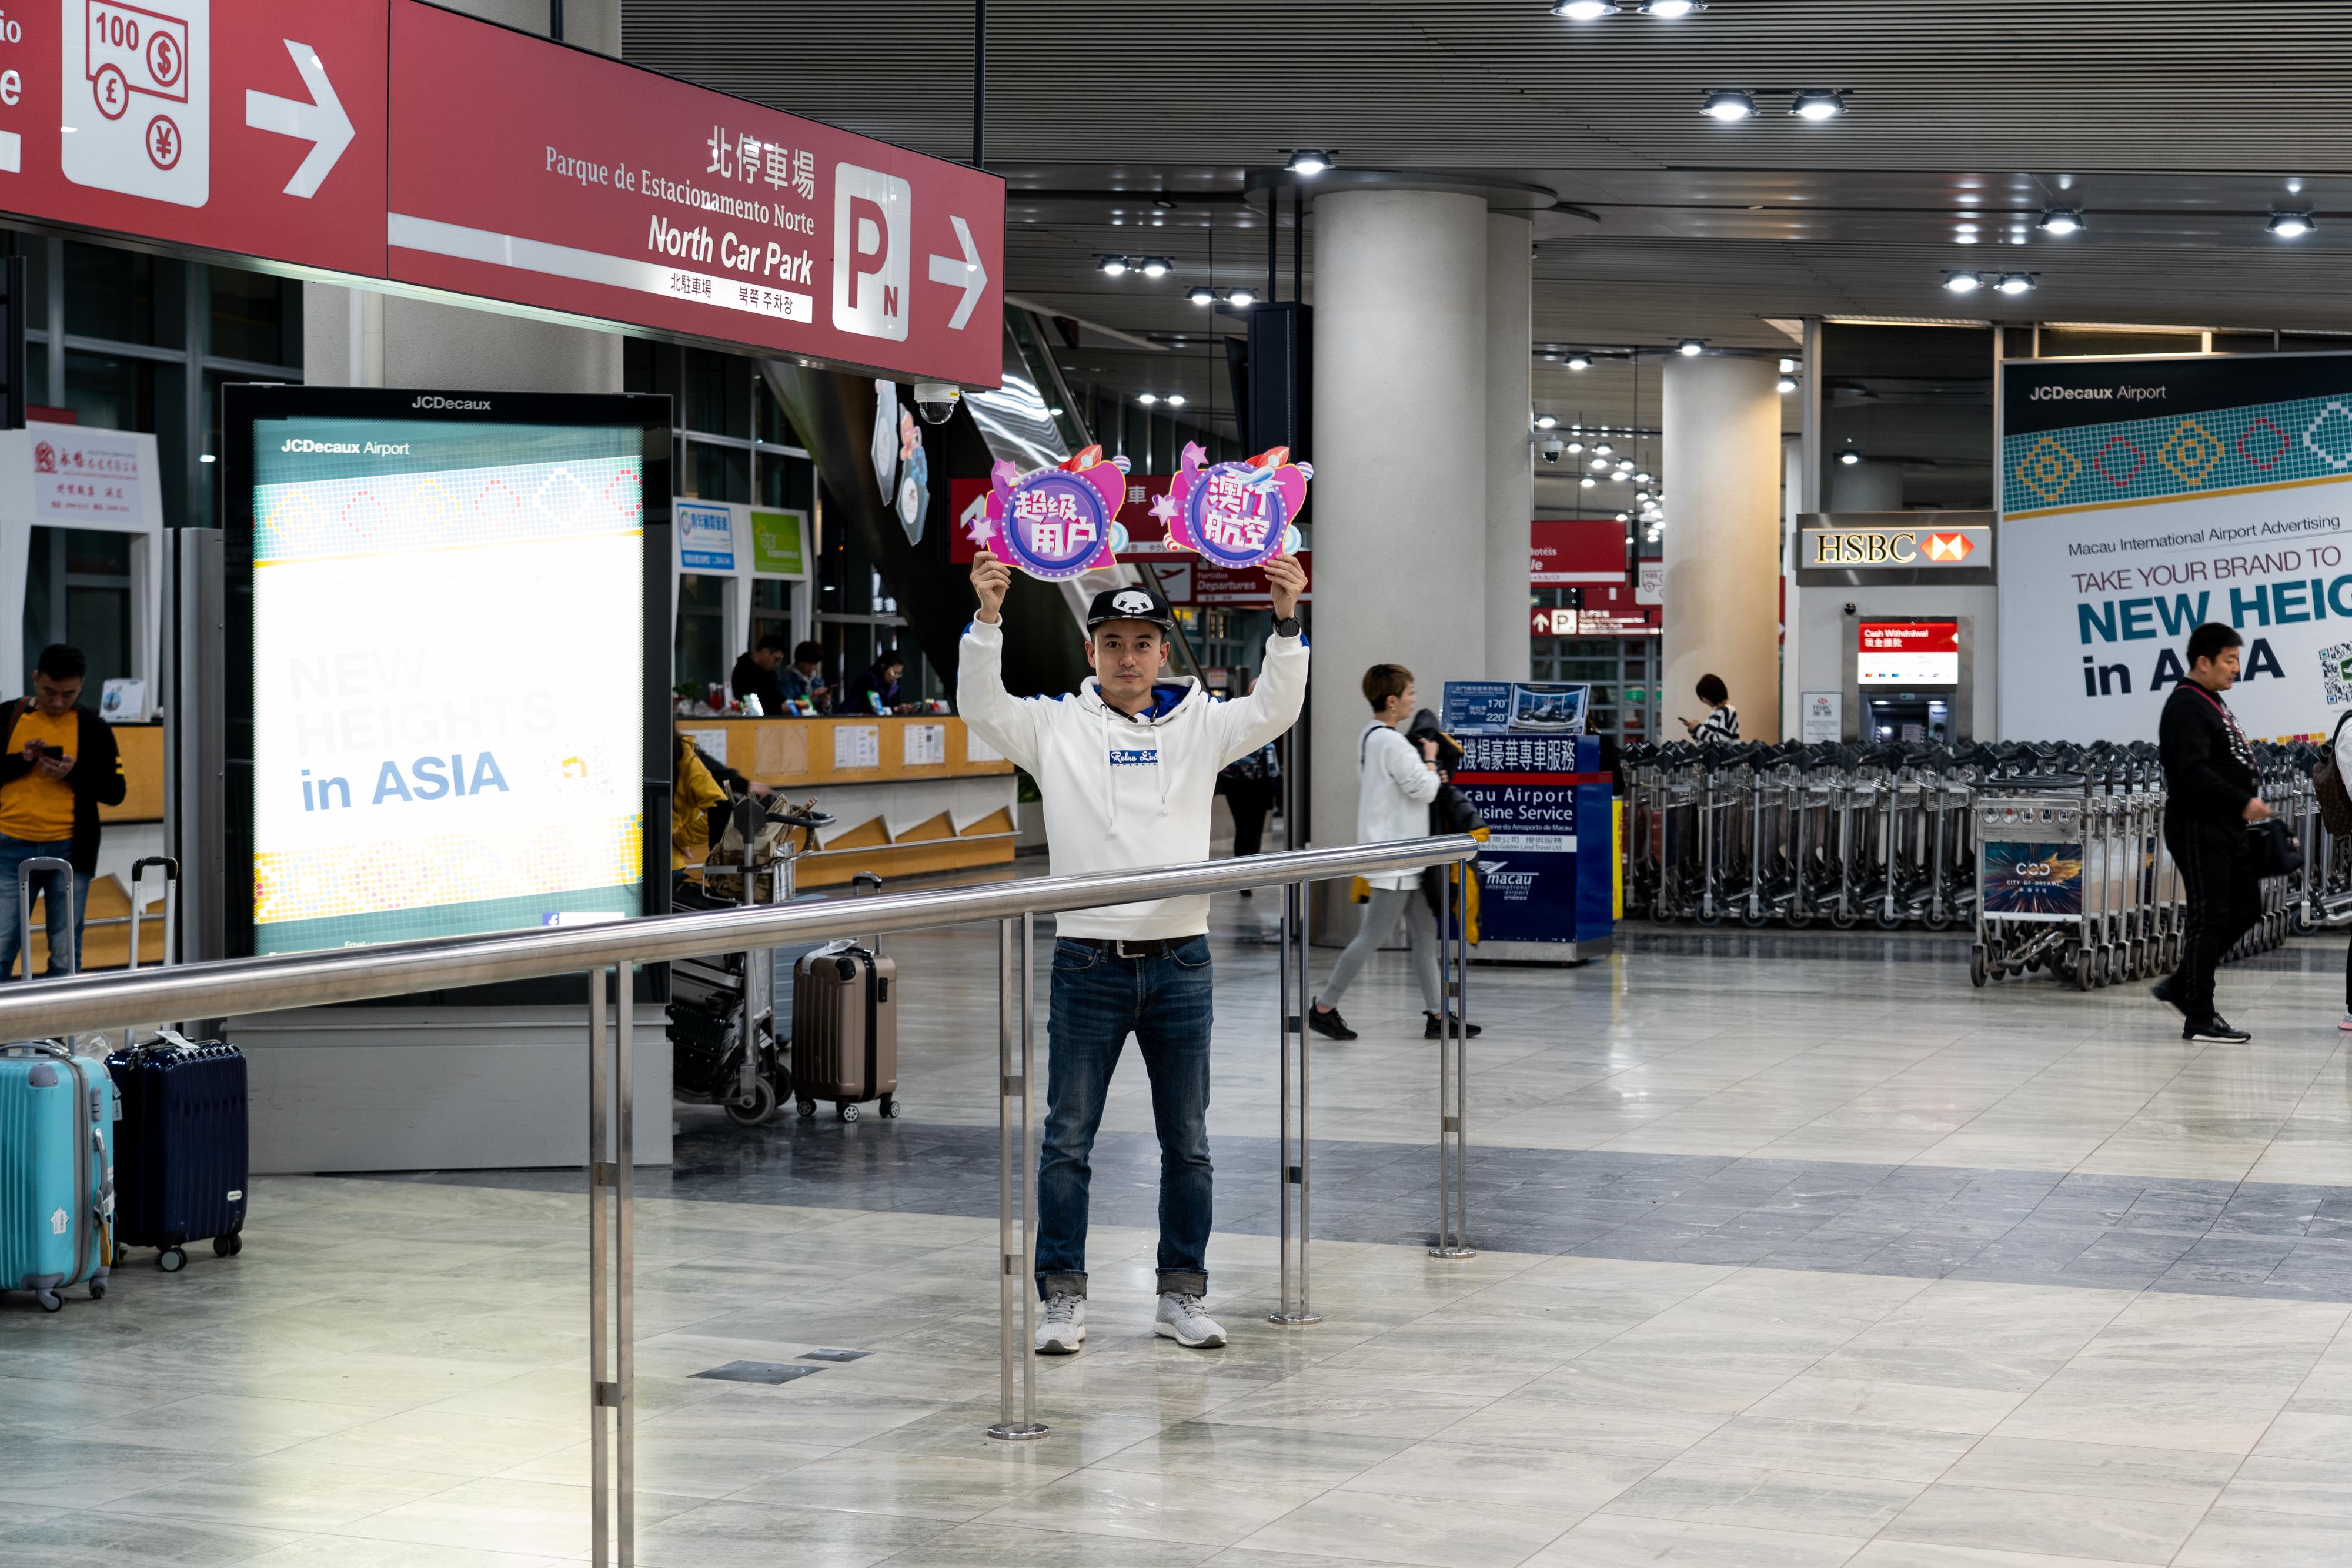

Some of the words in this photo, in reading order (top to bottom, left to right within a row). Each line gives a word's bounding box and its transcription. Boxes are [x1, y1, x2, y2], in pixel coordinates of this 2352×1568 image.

[96, 12, 139, 51] 100
[707, 125, 815, 200] 北停車場
[546, 146, 608, 186] Parque
[614, 162, 635, 192] de
[641, 169, 769, 224] Estacionamento
[773, 203, 814, 236] Norte
[647, 214, 714, 263] North
[721, 232, 761, 273] Car
[764, 242, 813, 285] Park
[848, 195, 888, 309] P
[671, 272, 711, 299] 北駐車場
[739, 286, 759, 308] 북쪽
[763, 292, 793, 315] 주차장
[884, 286, 898, 317] N
[412, 396, 492, 410] JCDecaux
[2030, 386, 2113, 400] JCDecaux
[2117, 385, 2167, 402] Airport
[281, 439, 360, 454] JCDecaux
[363, 441, 410, 457] Airport
[1013, 490, 1078, 523] 超级
[1122, 485, 1147, 505] 車
[1207, 473, 1268, 516] 澳门
[1031, 516, 1097, 557] 用户
[1204, 509, 1270, 551] 航空
[2069, 540, 2116, 556] Macau
[2120, 530, 2204, 551] International
[2209, 523, 2257, 542] Airport
[2260, 514, 2340, 536] Advertising
[1815, 532, 1916, 564] HSBC
[2071, 569, 2133, 593] TAKE
[2136, 560, 2208, 587] YOUR
[2214, 550, 2301, 579] BRAND
[2306, 546, 2341, 569] TO
[1197, 580, 1256, 593] Departures
[2077, 590, 2210, 644] NEW
[2229, 573, 2352, 628] HEIG
[1864, 629, 1883, 637] Cash
[1885, 628, 1929, 638] Withdrawal
[289, 646, 427, 700] NEW
[2082, 656, 2132, 697] in
[2150, 638, 2286, 691] AA
[1486, 713, 1505, 723] 220
[1488, 699, 1506, 709] 170
[295, 690, 558, 756] HEIGHTS
[301, 768, 352, 812] in
[372, 751, 510, 805] ASIA
[1465, 790, 1496, 802] cau
[1504, 788, 1573, 805] Airport
[1518, 805, 1573, 820] Service
[1486, 874, 1532, 884] macau
